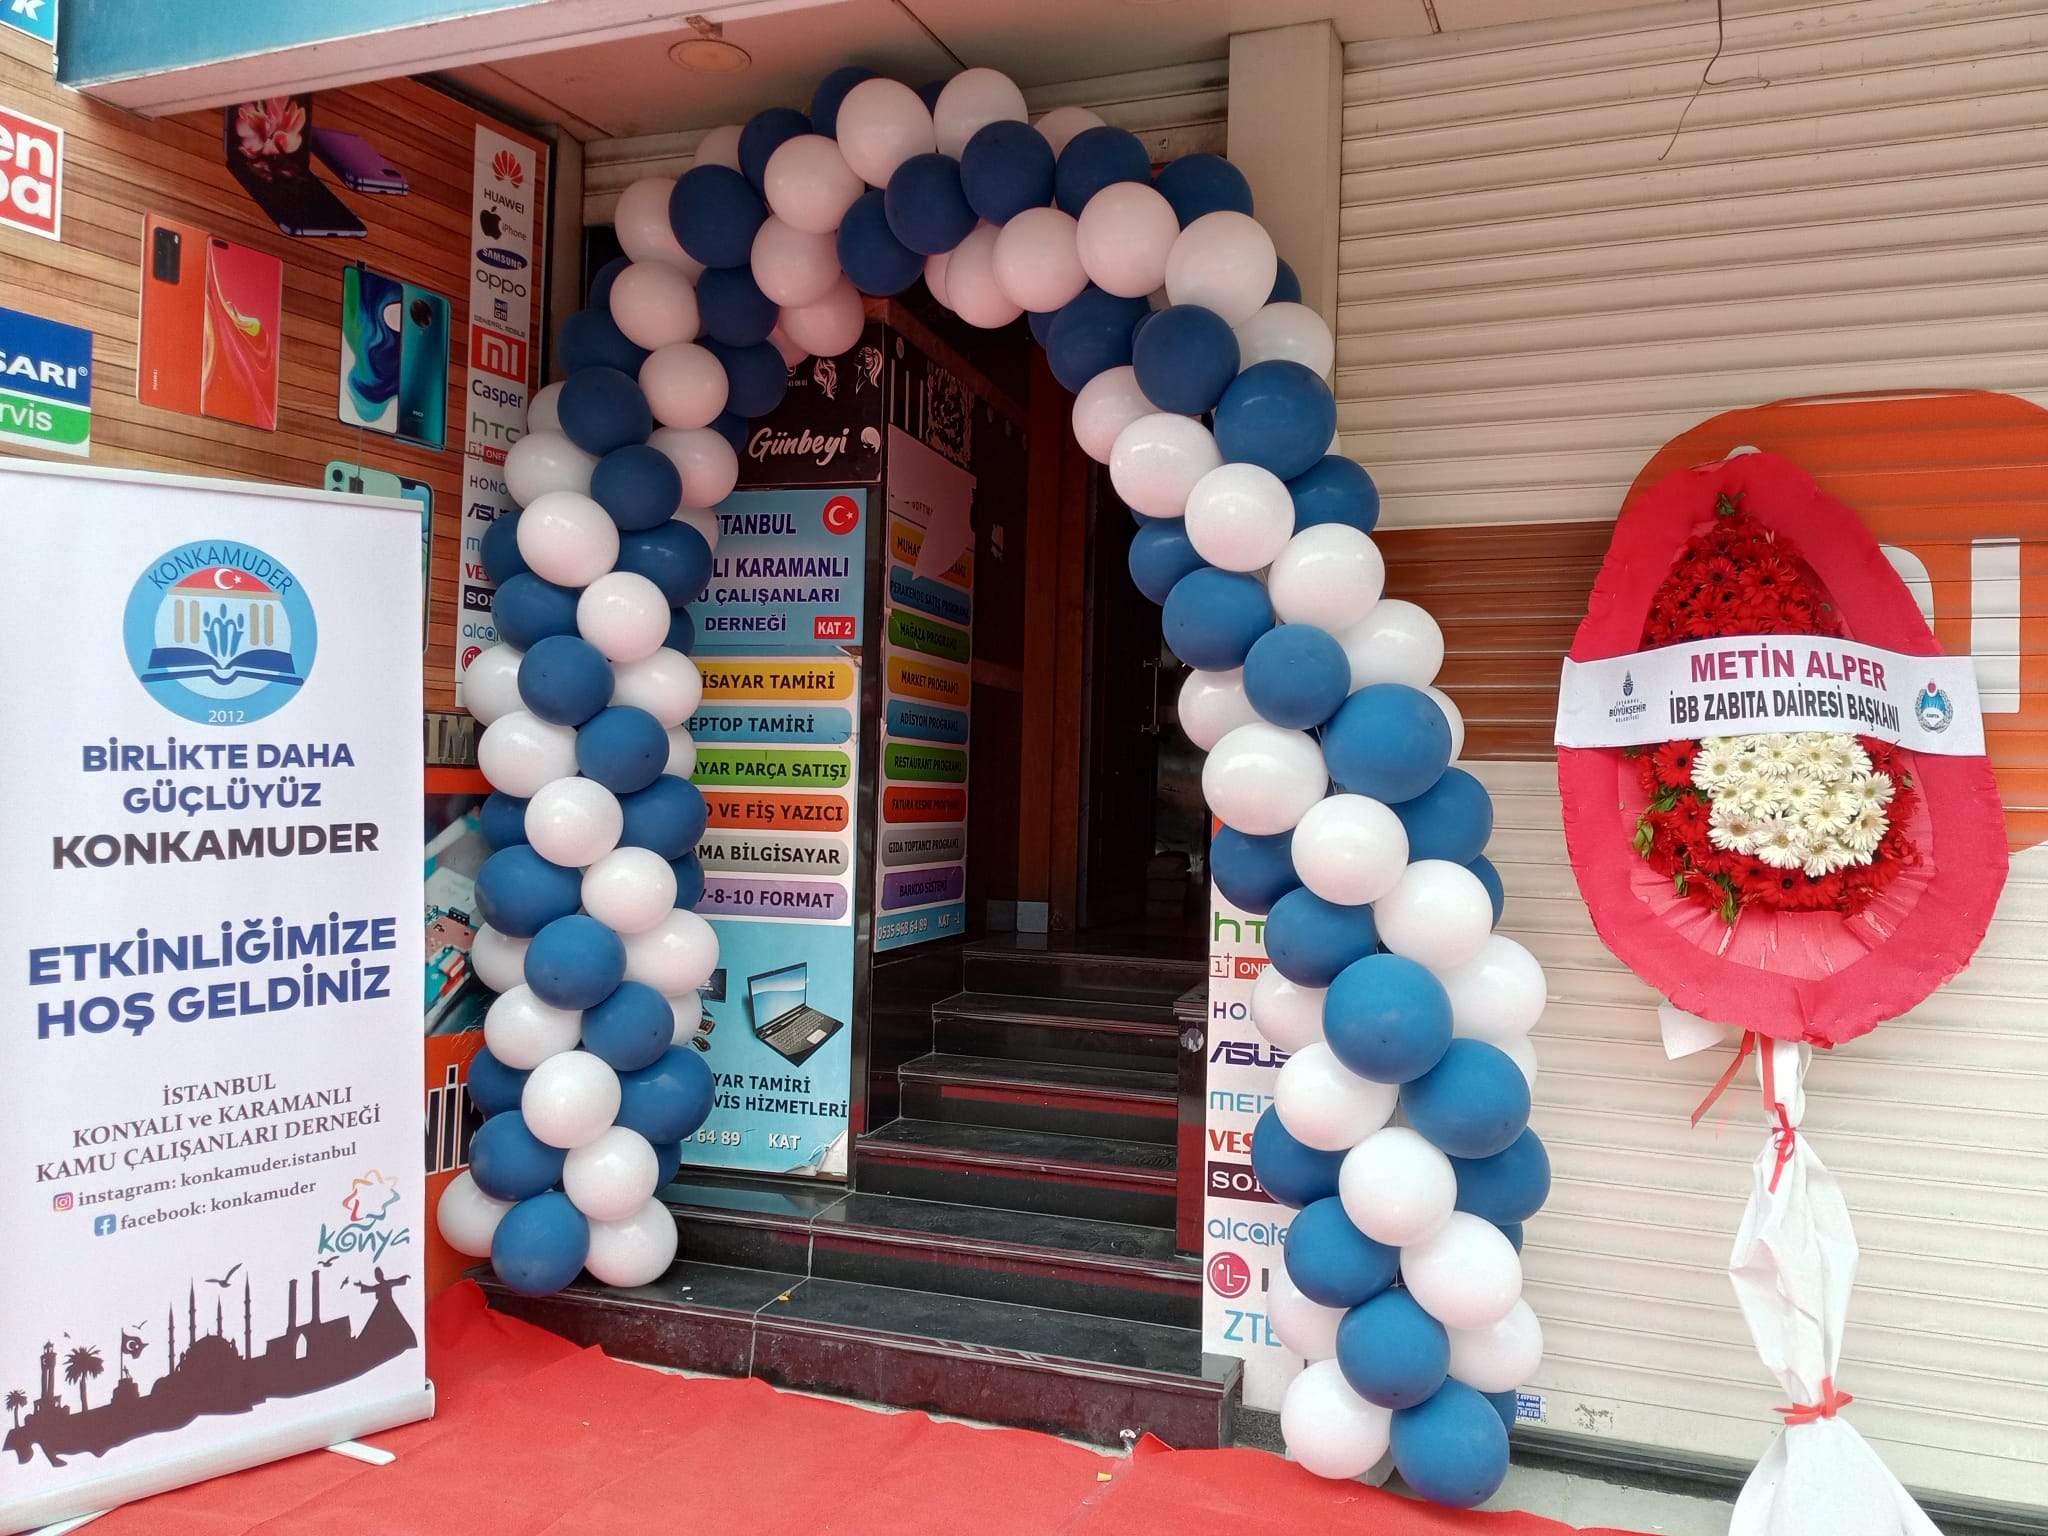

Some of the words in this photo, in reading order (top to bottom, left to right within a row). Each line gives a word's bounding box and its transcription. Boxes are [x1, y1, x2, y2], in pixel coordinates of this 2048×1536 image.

[484, 188, 525, 216] HUAWEI
[502, 223, 528, 241] iPhone
[482, 248, 522, 269] SAMSUNG
[472, 379, 523, 409] Casper
[749, 427, 851, 466] Günbeyi
[716, 513, 797, 535] TANBUL
[148, 546, 293, 595] KONKAMUDER
[736, 557, 849, 577] KARAMANLI
[715, 588, 840, 606] ÇALIŞANLARI
[705, 613, 786, 631] DERNEĞİ
[818, 622, 841, 635] KAT
[845, 621, 852, 635] 2
[900, 621, 925, 641] MAĞAZA
[1691, 642, 1795, 683] METİN
[1806, 649, 1887, 691] ALPER
[770, 671, 836, 690] TAMİRİ
[901, 670, 927, 688] MARKET
[928, 676, 959, 696] PROGRAMI
[208, 710, 245, 723] 2012
[1669, 690, 1699, 725] İBB
[1704, 690, 1767, 721] ZABITA
[1773, 682, 1843, 719] DAİRESİ
[1847, 695, 1900, 733] BAŞKANI
[686, 717, 743, 732] EPTOP
[748, 713, 815, 733] TAMİRİ
[900, 710, 927, 728] ADİSYON
[928, 715, 958, 732] PROGRAMI
[82, 737, 248, 772] BİRLİKTE
[257, 743, 355, 768] DAHA
[894, 756, 932, 771] RESTAURANT
[735, 762, 787, 779] PARÇA
[792, 764, 847, 781] SATIŞI
[123, 776, 321, 817] GÜÇLÜYÜZ
[719, 803, 740, 818] VE
[746, 801, 775, 823] FİŞ
[780, 805, 843, 822] YAZICI
[53, 822, 379, 869] KONKAMUDER
[731, 842, 841, 865] BİLGİSAYAR
[888, 840, 903, 853] GIDA
[904, 839, 931, 852] TOPTANCI
[932, 838, 959, 850] PROGRAMI
[760, 890, 834, 909] FORMAT
[878, 922, 895, 941] 0535
[909, 919, 918, 934] 64
[919, 917, 928, 931] 89
[938, 913, 950, 928] KAT
[29, 912, 397, 986] ETKİNLİĞİMİZE
[37, 991, 155, 1039] HOŞ
[167, 958, 391, 1023] GELDİNİZ
[162, 1073, 276, 1106] İSTANBUL
[749, 1074, 811, 1094] TAMİRİ
[73, 1113, 184, 1148] KONYALI
[187, 1113, 212, 1129] ve
[219, 1087, 352, 1124] KARAMANLI
[745, 1094, 848, 1118] HİZMETLERİ
[36, 1152, 116, 1182] KAMU
[124, 1125, 278, 1172] ÇALIŞANLARI
[285, 1104, 382, 1139] DERNEĞİ
[697, 1129, 717, 1144] 64
[721, 1130, 741, 1146] 89
[769, 1133, 801, 1150] KAT
[78, 1177, 177, 1208] instagram:
[181, 1142, 357, 1187] konkamuder.istanbul
[121, 1202, 206, 1230] facebook:
[211, 1181, 317, 1214] konkamuder
